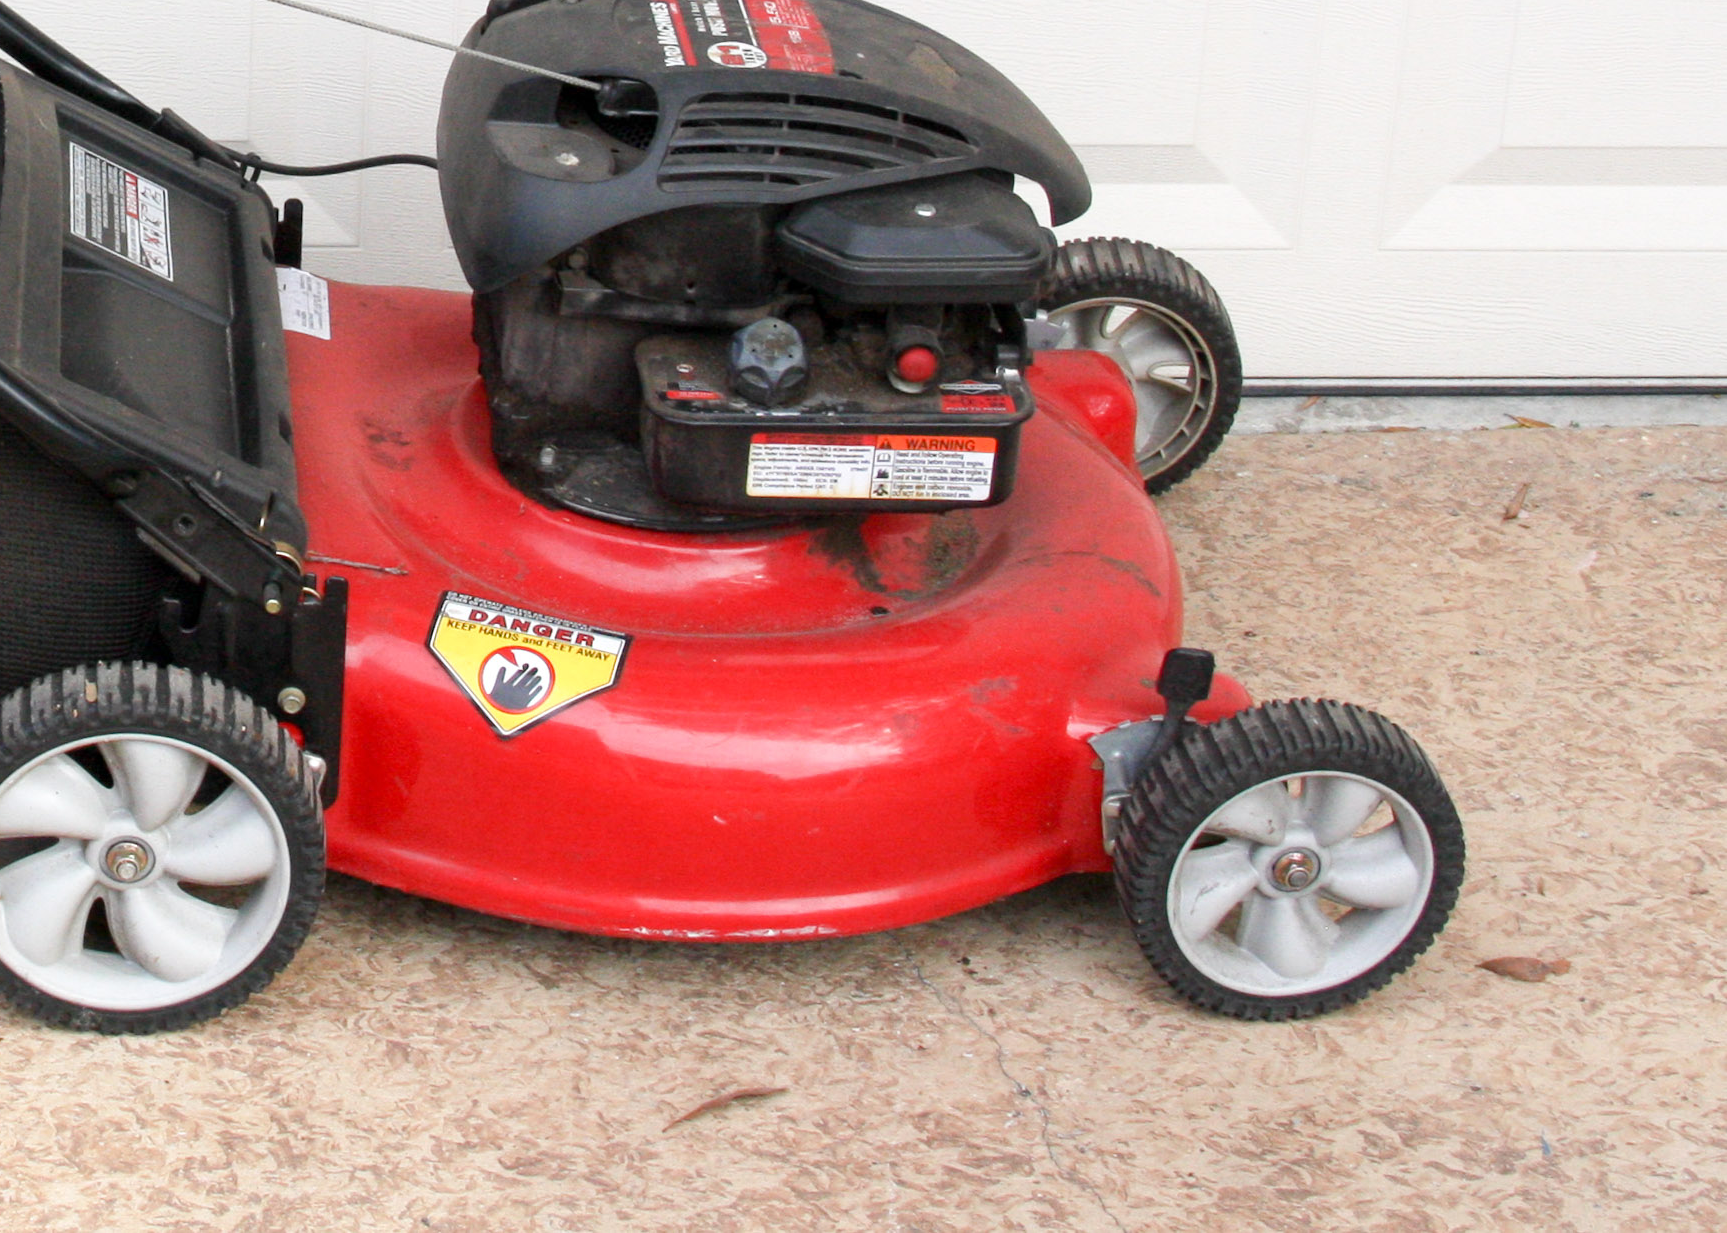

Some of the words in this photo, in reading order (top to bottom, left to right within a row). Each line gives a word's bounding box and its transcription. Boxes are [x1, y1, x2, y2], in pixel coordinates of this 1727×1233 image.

[649, 2, 680, 45] MACHINES
[663, 46, 686, 67] YARD
[906, 438, 975, 452] WARNING
[447, 619, 477, 632] KEEP
[479, 626, 519, 641] HANDS
[522, 637, 543, 647] and
[545, 641, 574, 653] FEET
[575, 648, 611, 662] AWAY
[468, 609, 595, 647] DANGER
